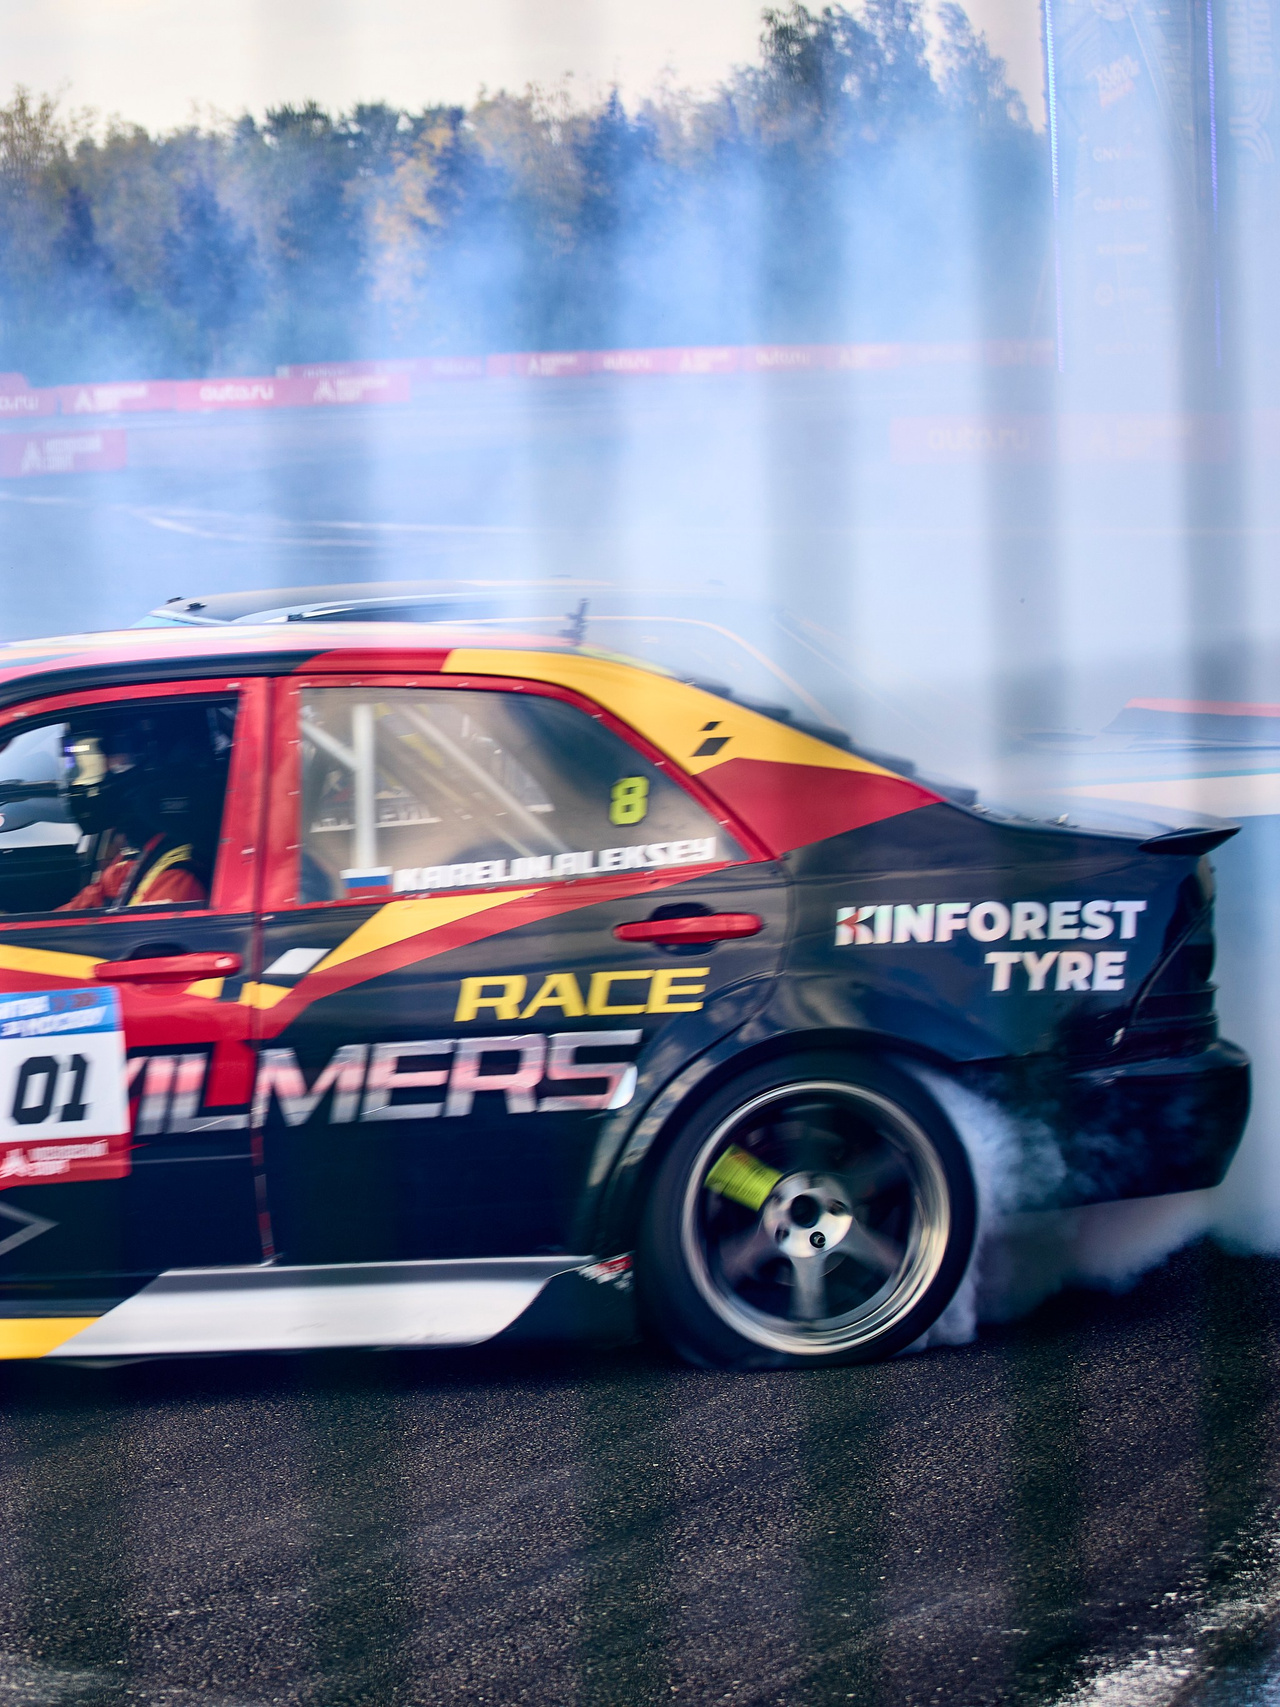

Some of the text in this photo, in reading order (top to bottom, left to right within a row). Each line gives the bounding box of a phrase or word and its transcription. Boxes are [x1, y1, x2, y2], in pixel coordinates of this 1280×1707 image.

[608, 776, 650, 827] 8
[834, 901, 1148, 947] KINFOREST
[454, 967, 711, 1023] RACE
[984, 951, 1128, 992] TYRE
[11, 1053, 91, 1126] 01
